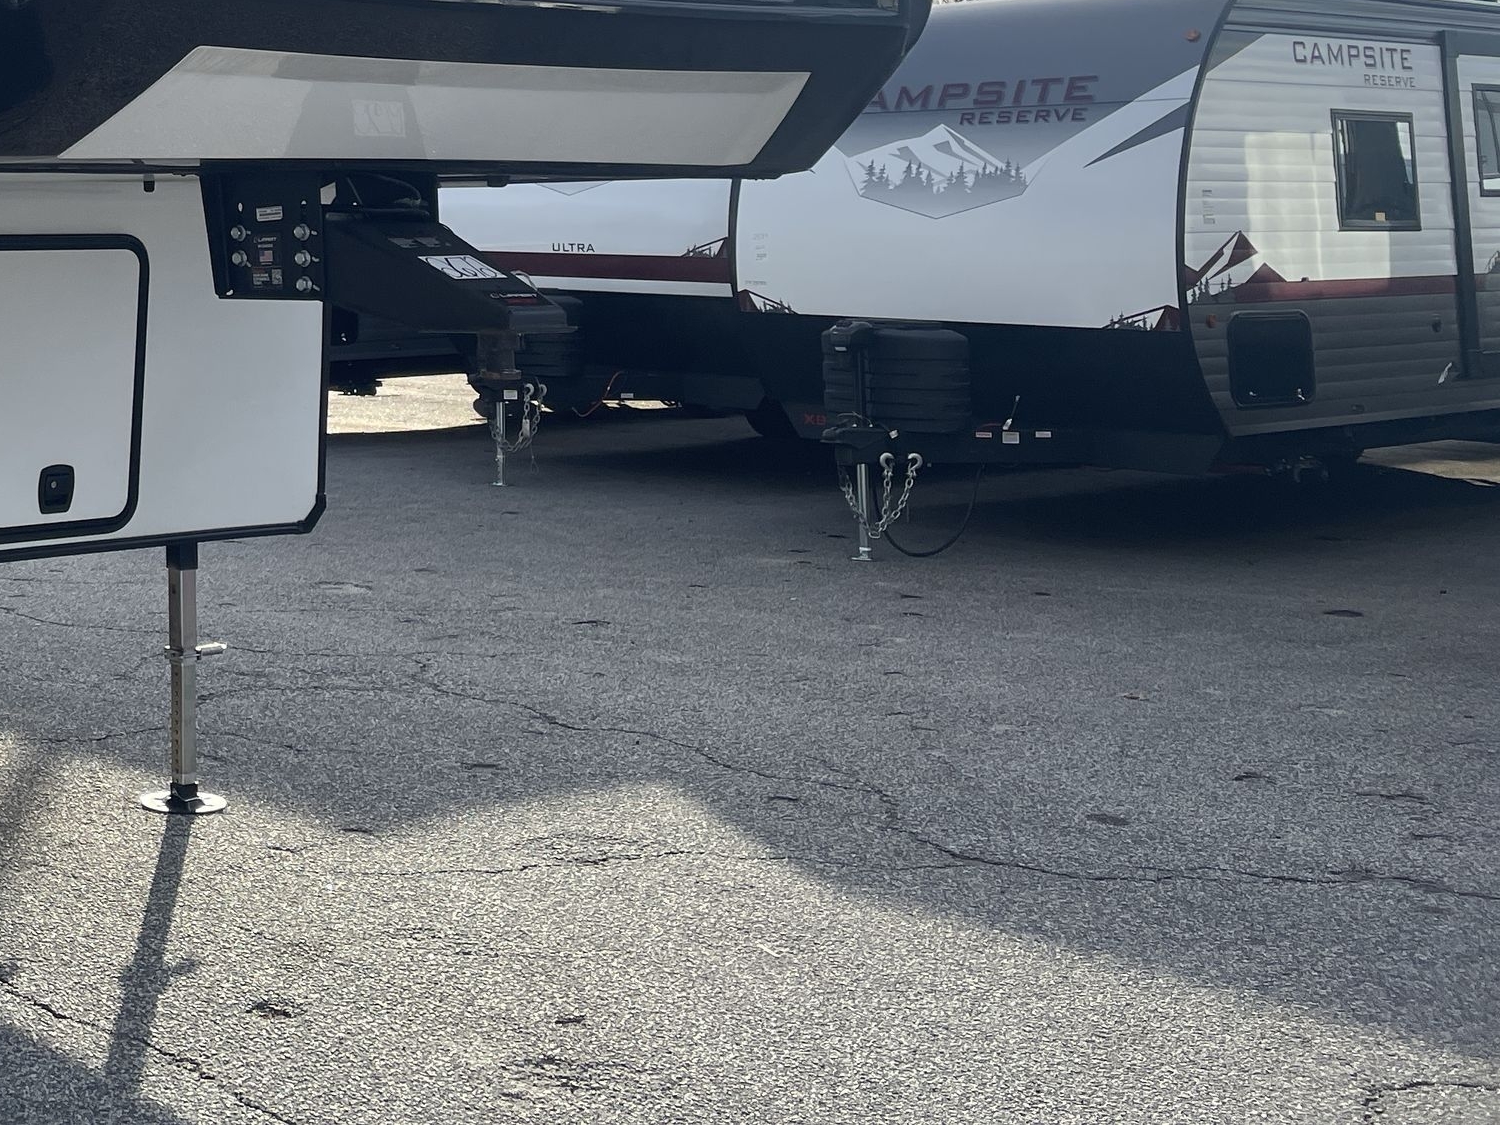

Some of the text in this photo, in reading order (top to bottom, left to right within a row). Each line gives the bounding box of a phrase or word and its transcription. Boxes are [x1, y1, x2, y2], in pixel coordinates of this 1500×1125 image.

[1292, 40, 1413, 71] CAMPSITE
[1363, 74, 1417, 88] RESERVE
[869, 75, 1099, 111] AMPSITE
[958, 107, 1089, 126] RESERVE
[552, 242, 595, 253] ULTRA
